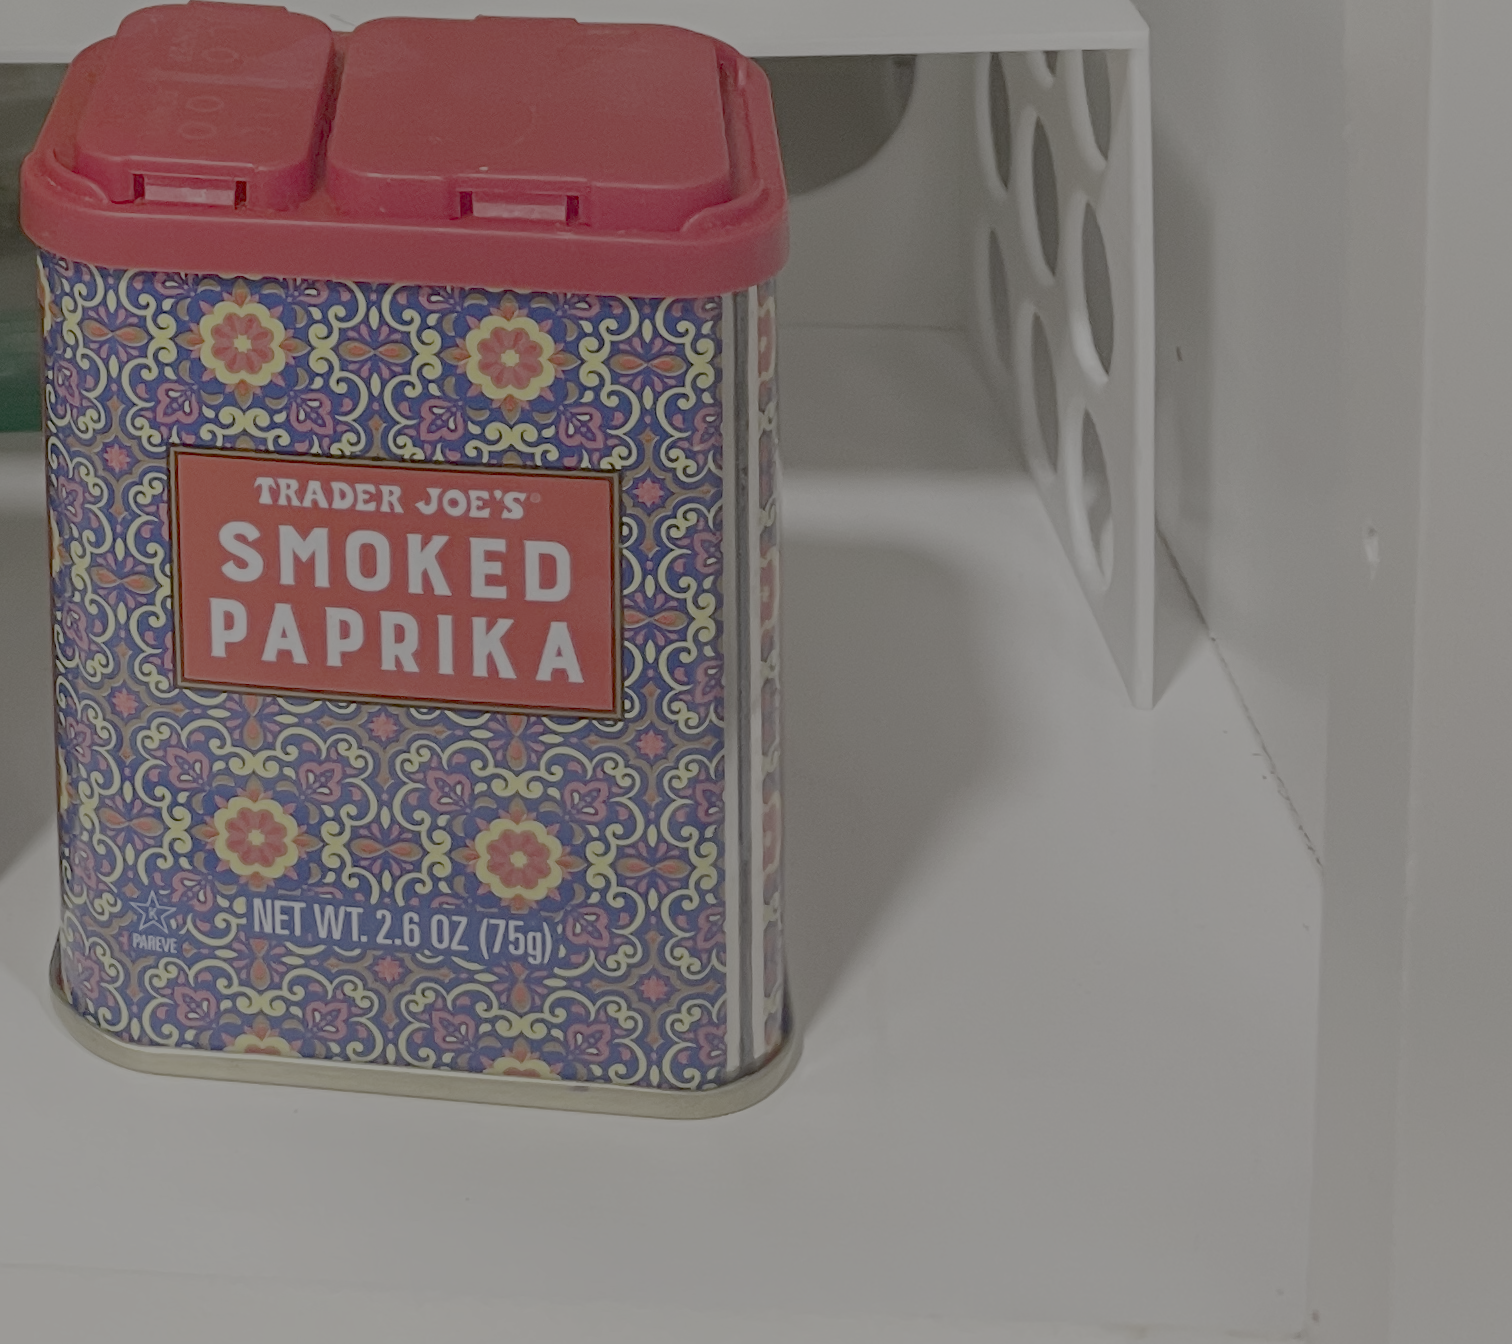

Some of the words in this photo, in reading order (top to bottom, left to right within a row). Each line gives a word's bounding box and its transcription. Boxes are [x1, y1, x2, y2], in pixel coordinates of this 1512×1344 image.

[254, 477, 402, 514] TRADER
[416, 487, 526, 521] JOE'S
[219, 521, 573, 601] SMOKED
[210, 598, 584, 683] PAPRIKA
[132, 932, 177, 953] PAREVE
[252, 897, 307, 937] NET
[312, 903, 368, 943] WT.
[376, 908, 421, 948] 2.6
[430, 914, 469, 953] OZ
[479, 917, 553, 965] (75g)
